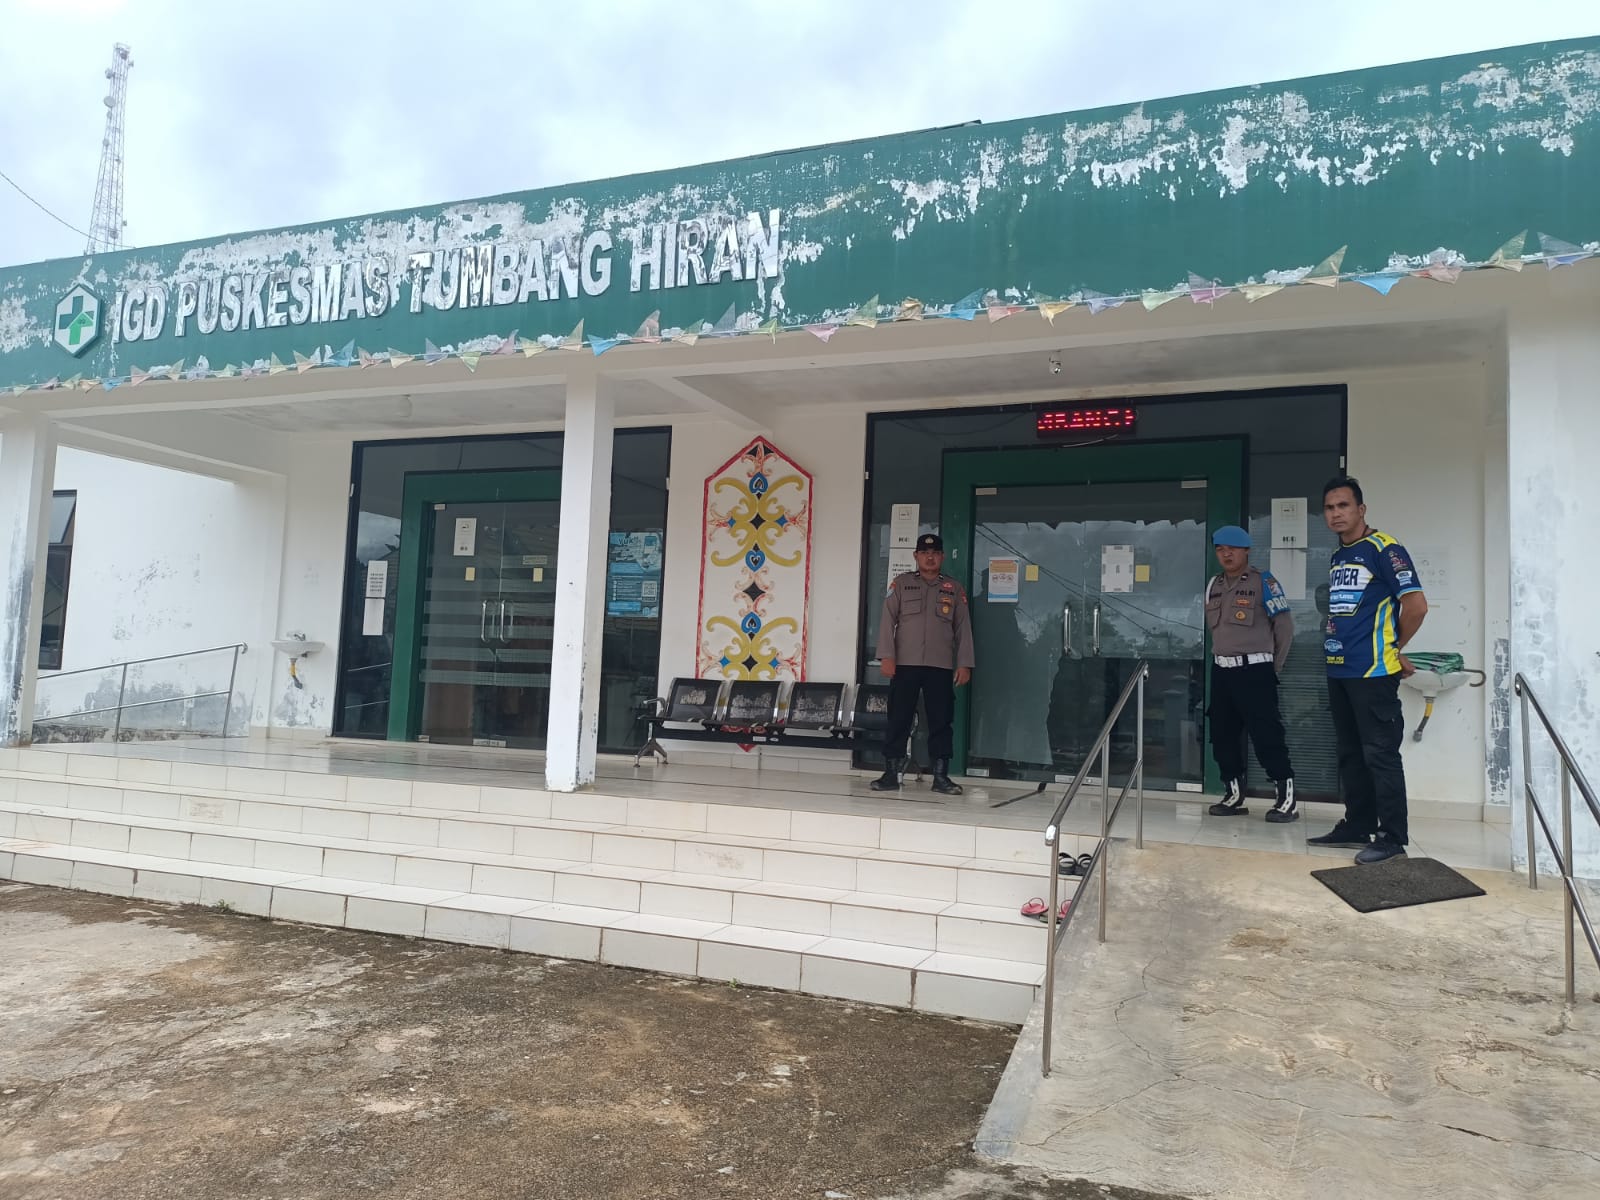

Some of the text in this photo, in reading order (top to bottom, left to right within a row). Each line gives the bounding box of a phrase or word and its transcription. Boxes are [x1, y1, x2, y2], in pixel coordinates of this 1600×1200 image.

[110, 209, 782, 344] IGD PUSKESMAS TUMBANG HIRAN
[1235, 589, 1256, 597] POLRI
